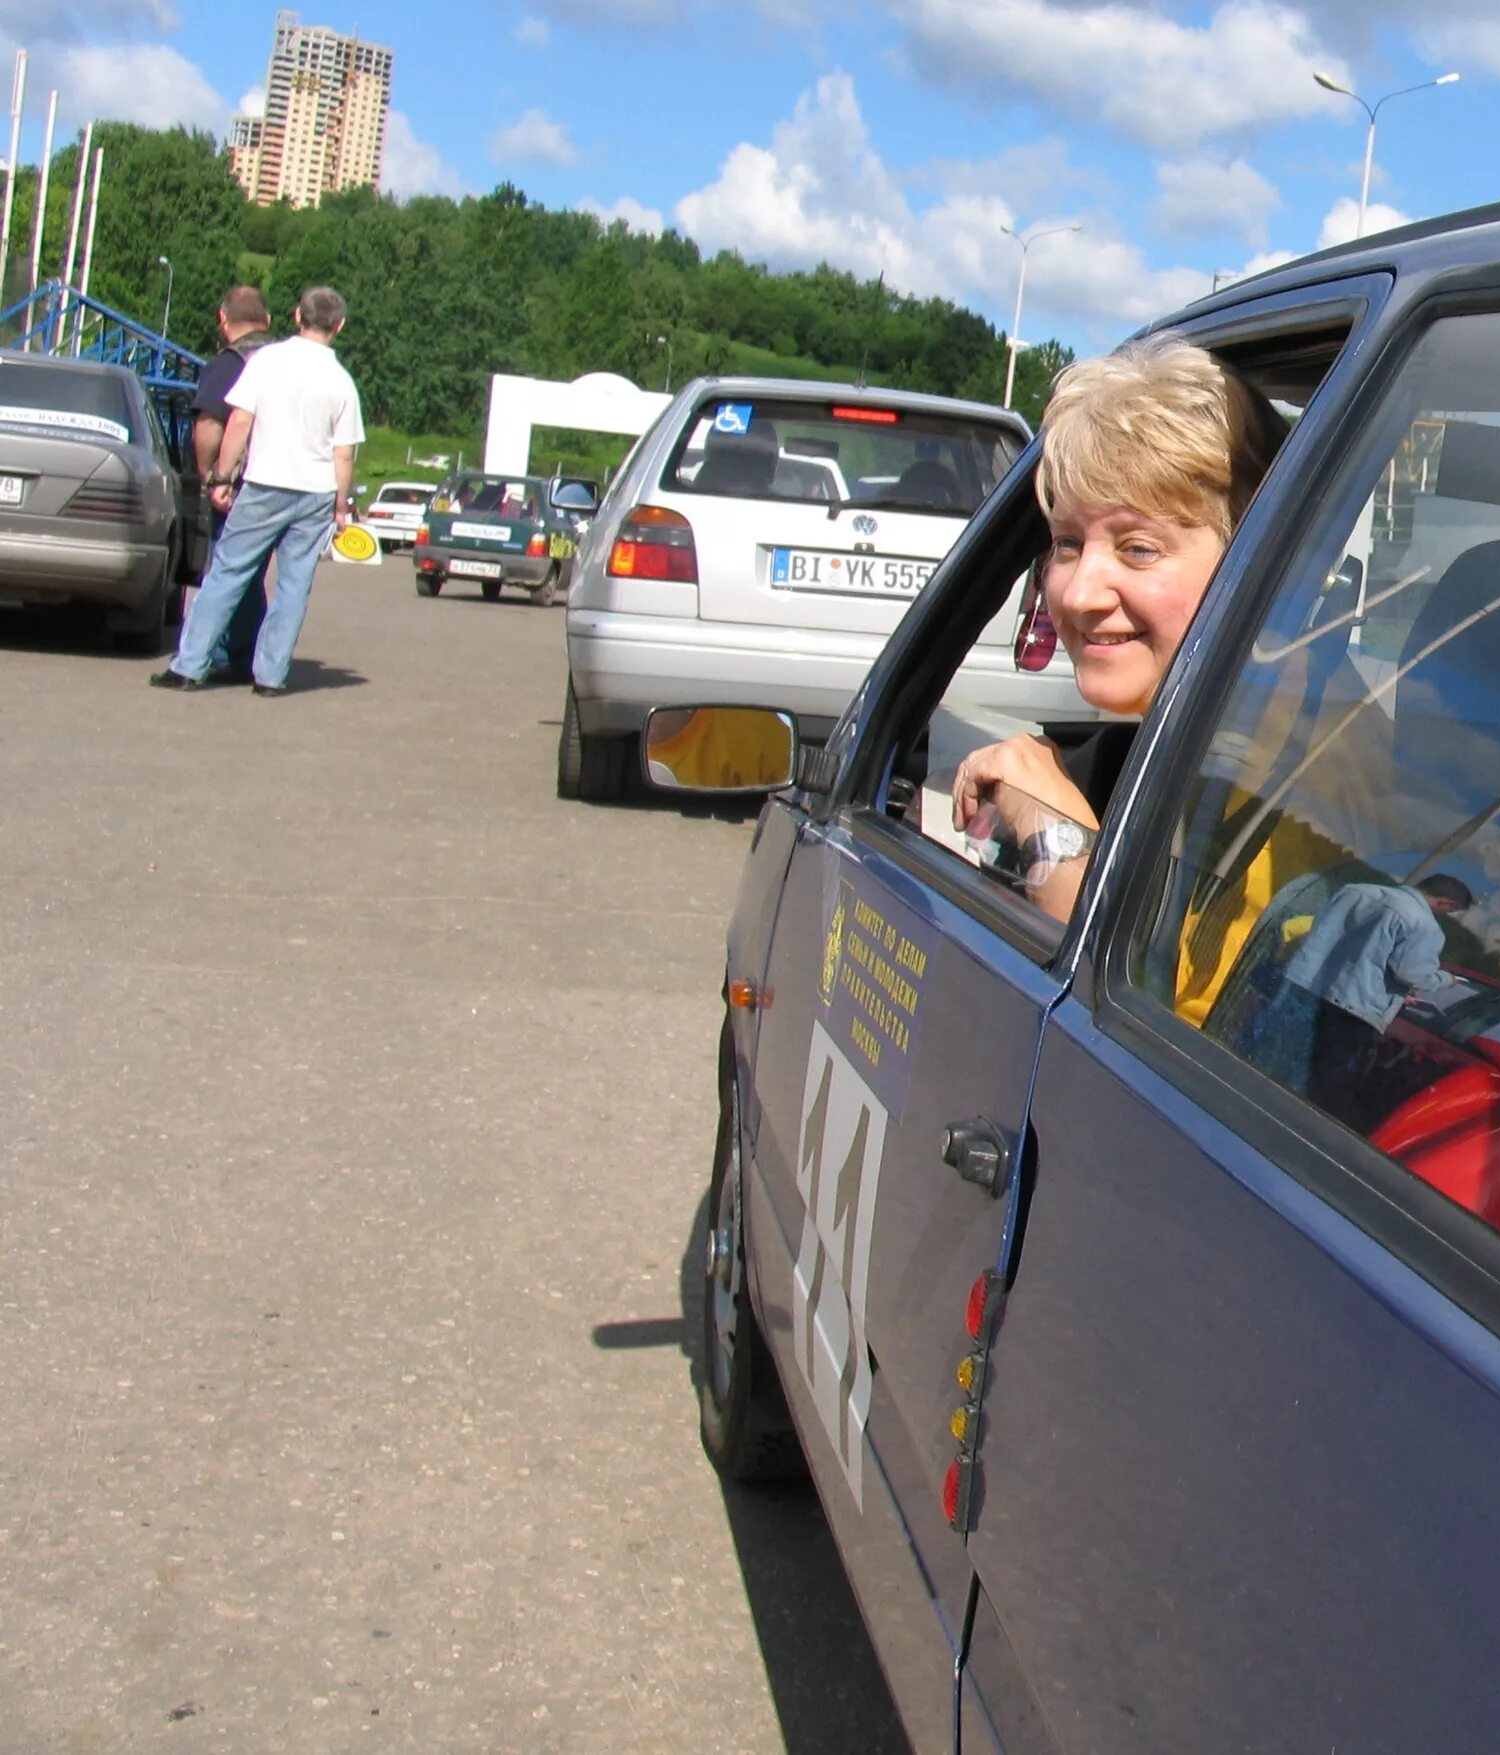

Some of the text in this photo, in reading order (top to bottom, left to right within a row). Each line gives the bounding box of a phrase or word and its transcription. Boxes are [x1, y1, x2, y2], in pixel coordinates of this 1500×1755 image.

[791, 556, 938, 591] BI YK 555
[883, 924, 896, 952] ПО
[895, 937, 928, 979] ДЕЛАМ
[841, 962, 910, 1054] ПРАВИТЕЛЬСТВА
[851, 1016, 881, 1067] МОСКВЫ
[802, 1055, 871, 1471] 11
